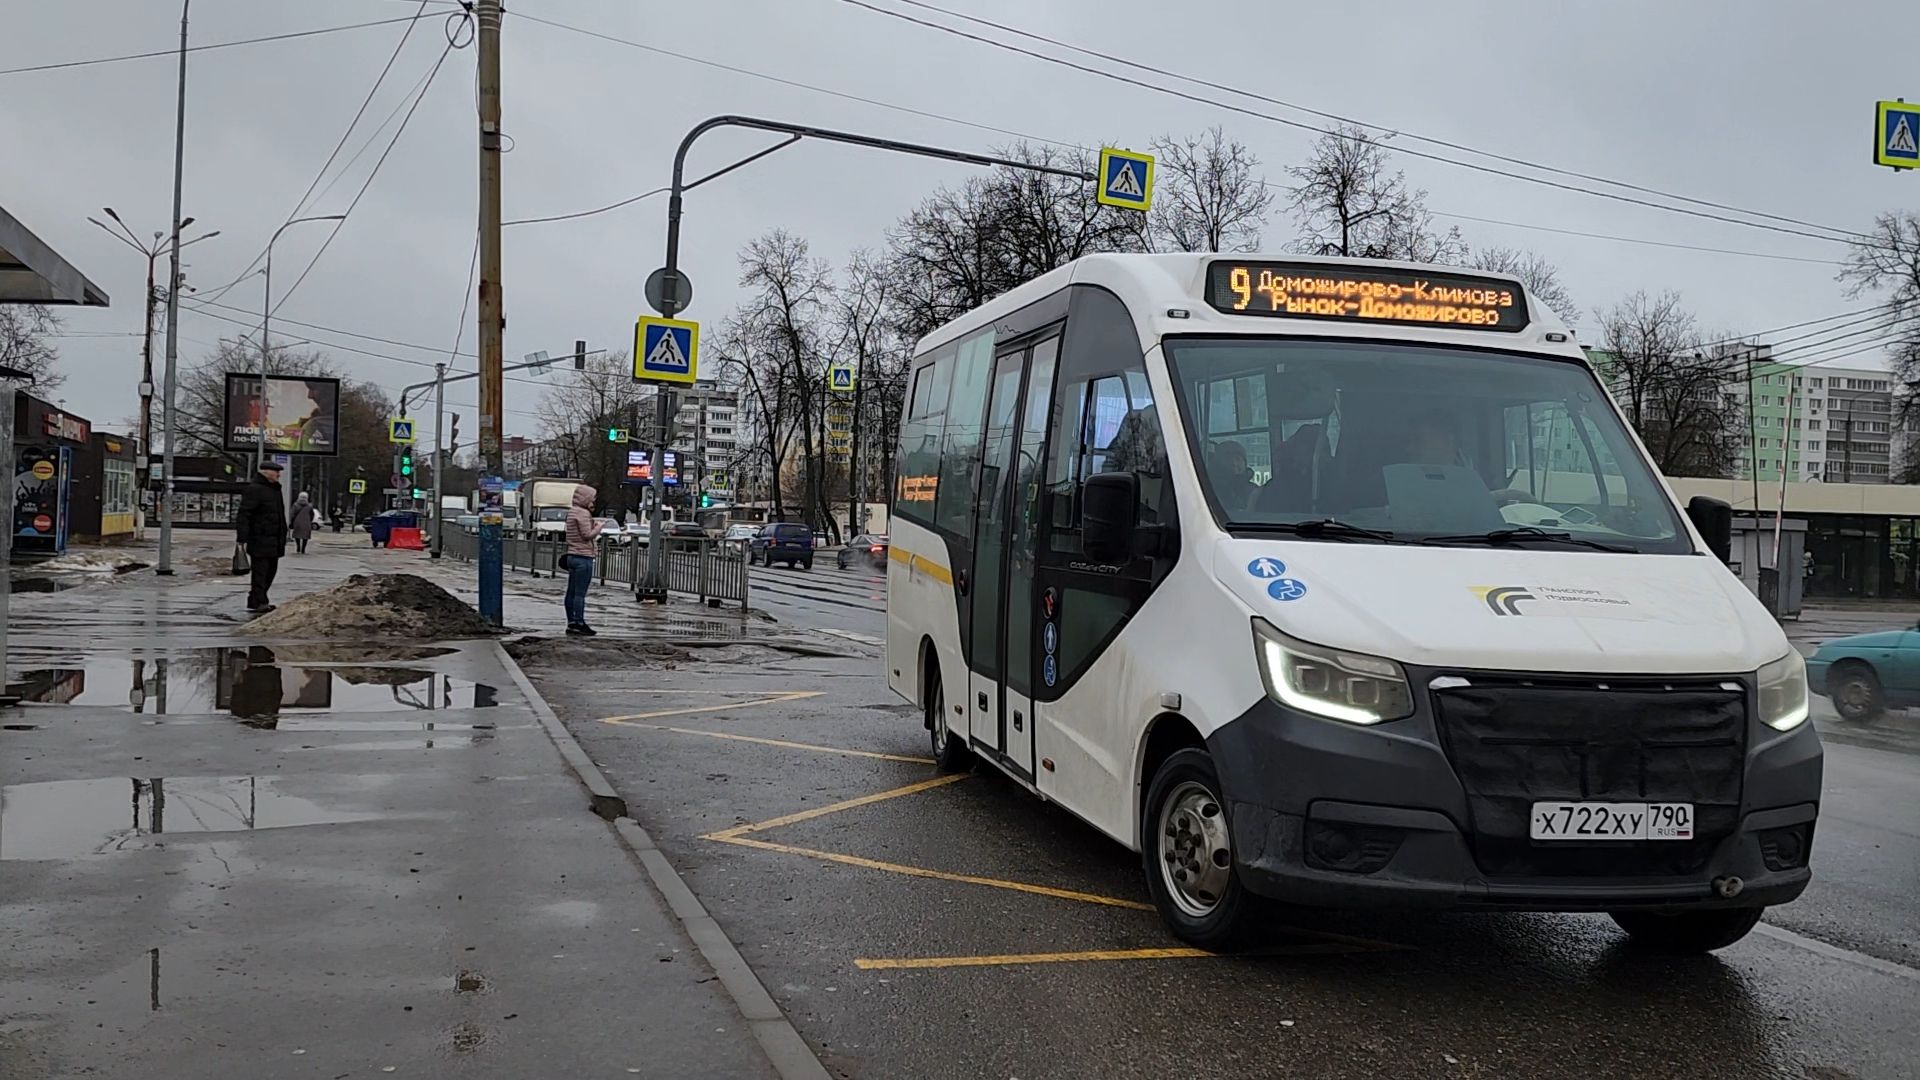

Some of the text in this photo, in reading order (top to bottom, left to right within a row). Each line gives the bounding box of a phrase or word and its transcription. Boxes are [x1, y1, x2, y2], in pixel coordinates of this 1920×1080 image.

[1231, 268, 1250, 310] 9
[1272, 291, 1499, 325] Рынок-Доможирово
[1650, 806, 1687, 827] 790
